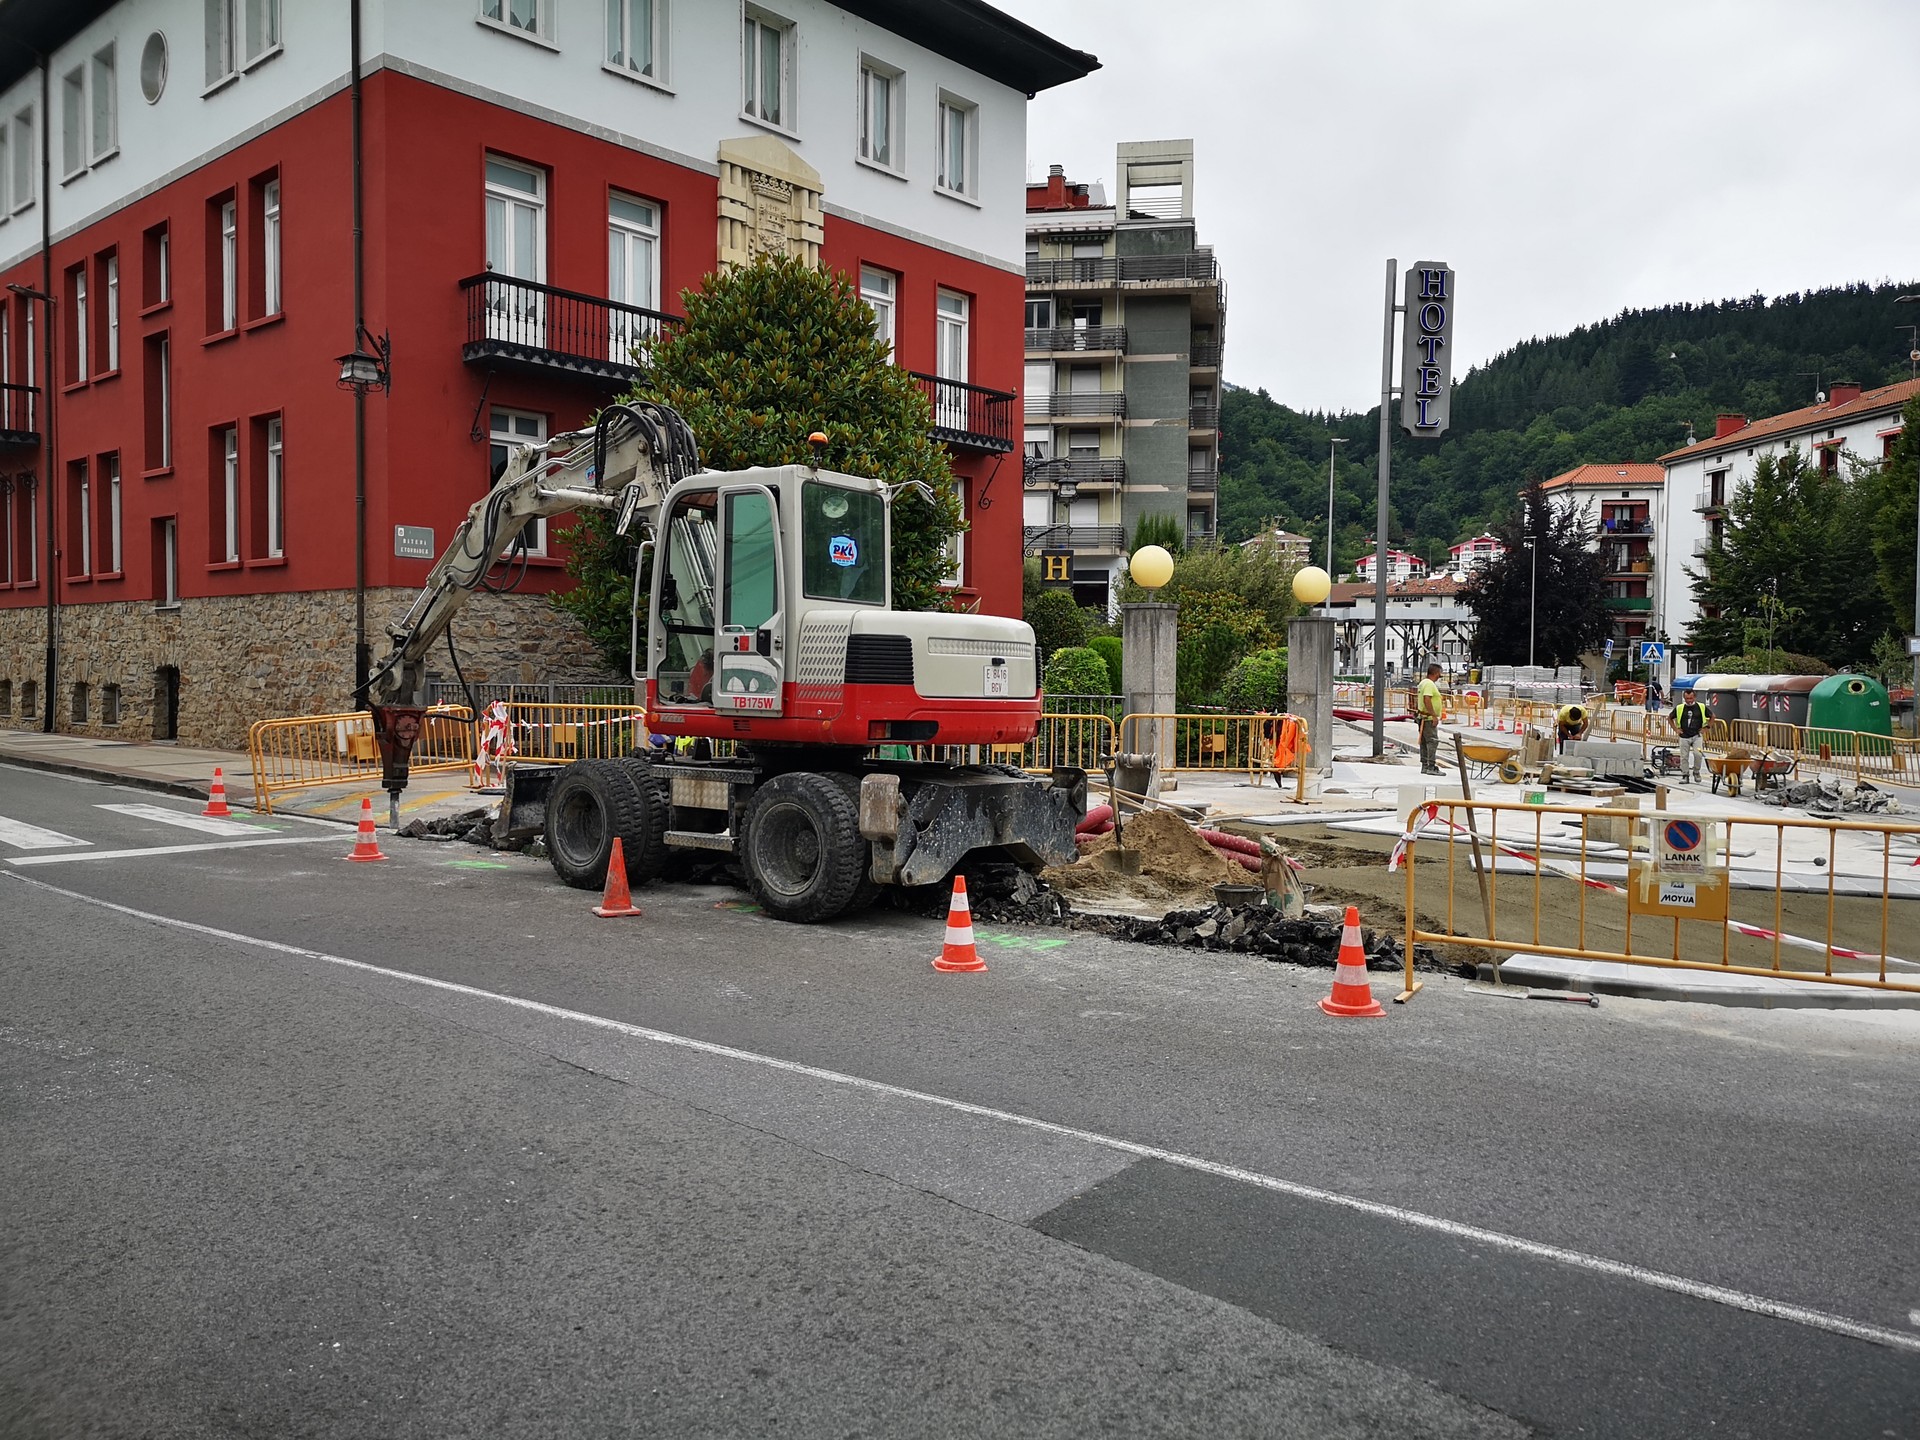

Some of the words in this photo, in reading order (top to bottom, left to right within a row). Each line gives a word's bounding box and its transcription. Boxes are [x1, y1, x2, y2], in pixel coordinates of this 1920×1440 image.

[1416, 268, 1449, 429] HOTEL
[1044, 555, 1071, 581] H
[992, 668, 1007, 680] 8416
[732, 696, 774, 709] TB175W
[1665, 853, 1701, 862] LANAK
[1660, 894, 1695, 904] MOYUA
